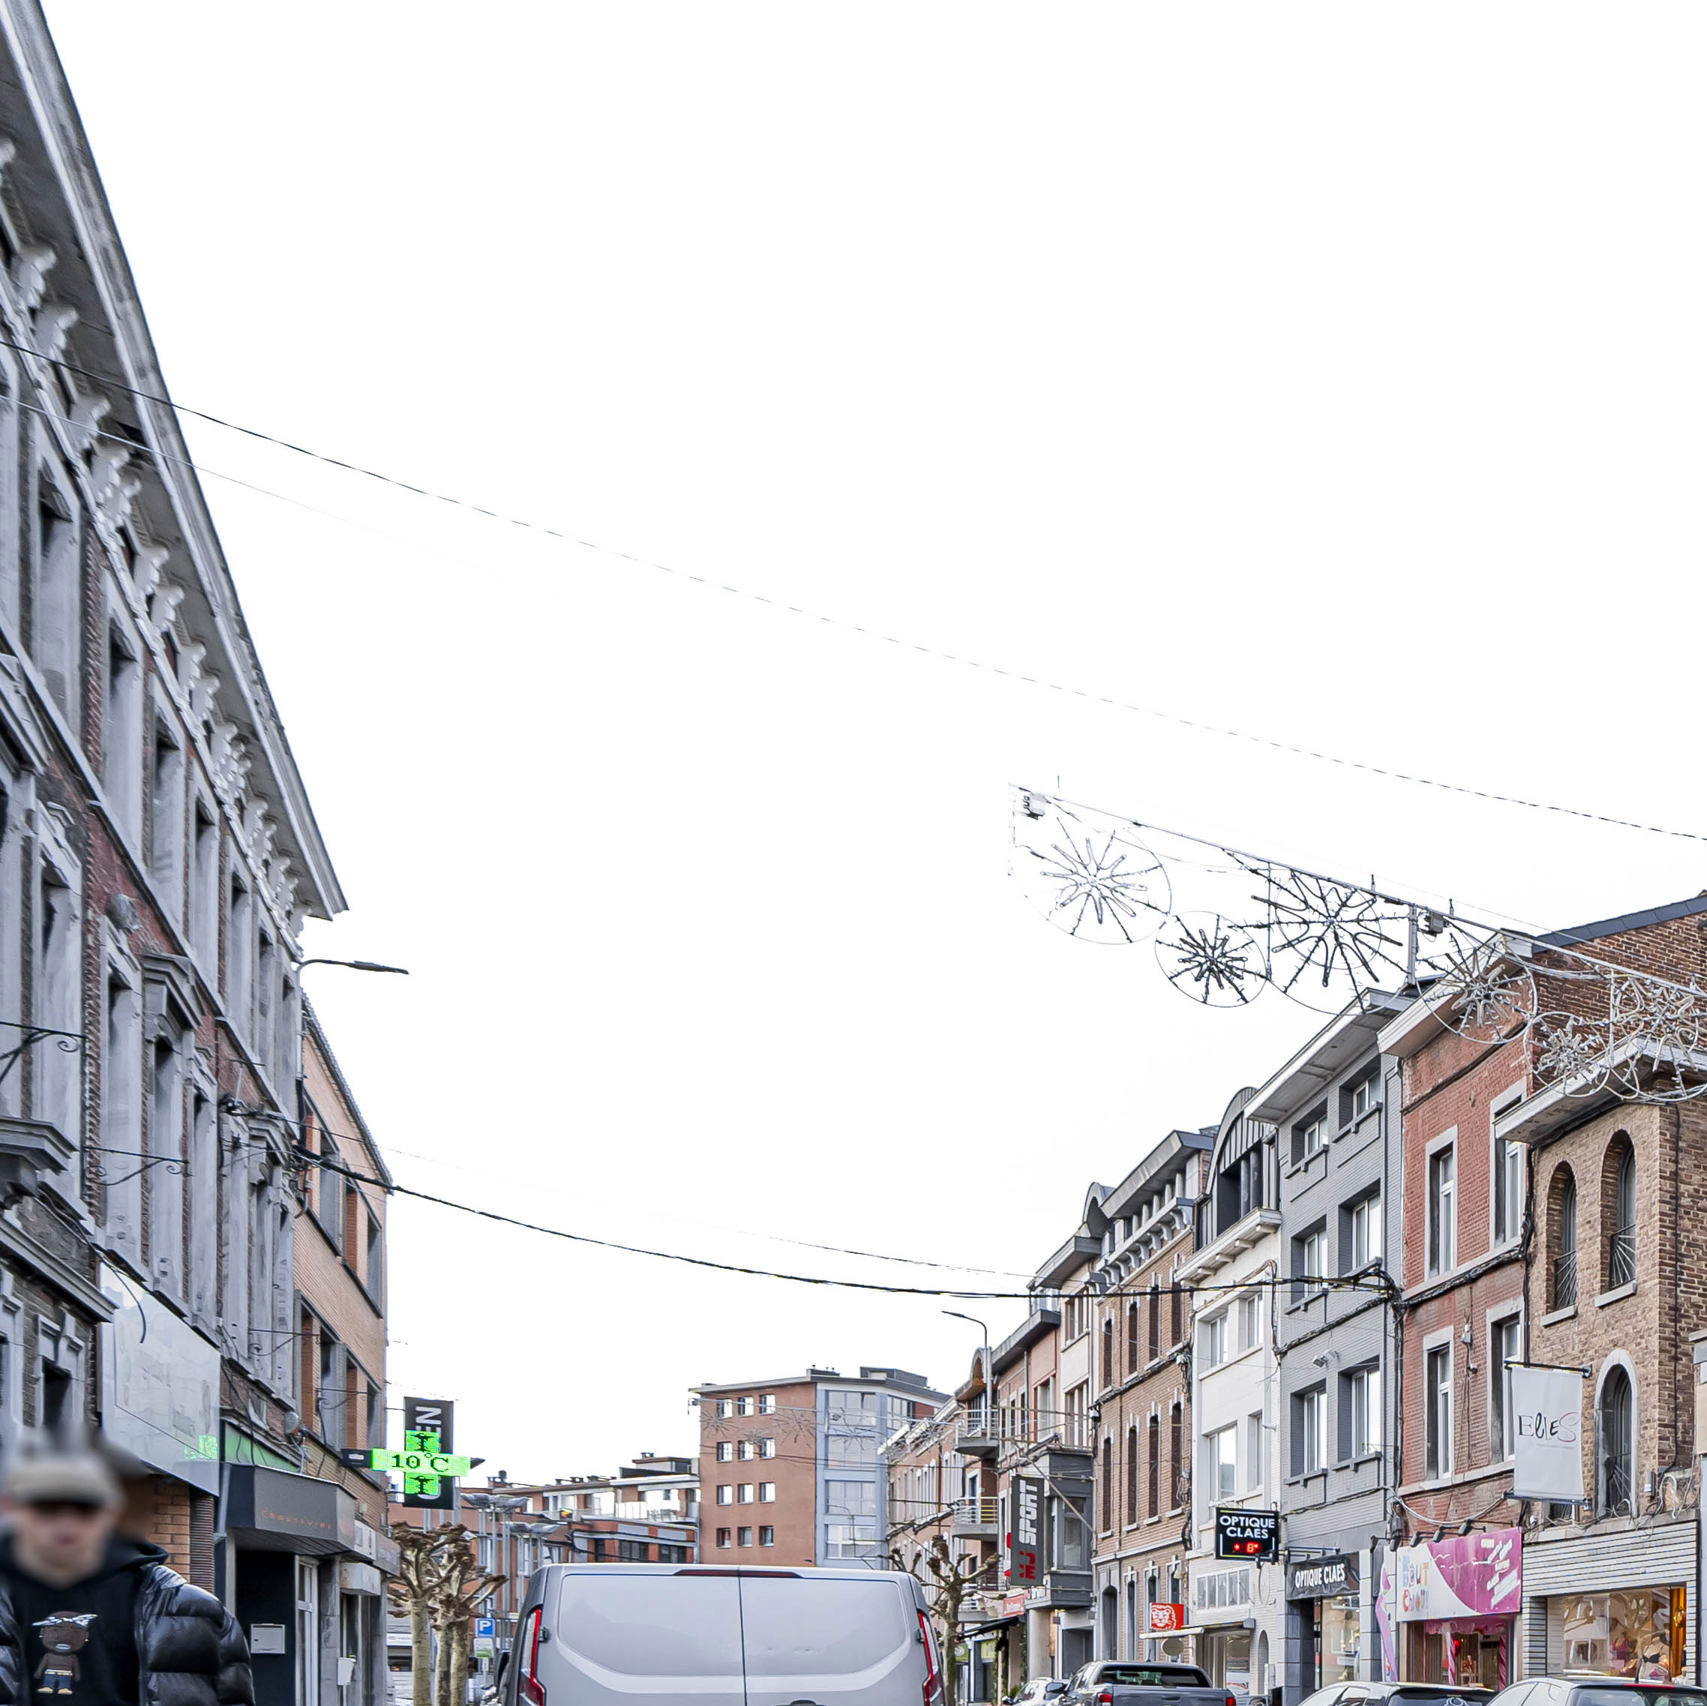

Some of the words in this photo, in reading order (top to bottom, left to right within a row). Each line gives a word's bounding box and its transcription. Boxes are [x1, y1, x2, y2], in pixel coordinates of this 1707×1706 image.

[1018, 1479, 1038, 1546] SPORT
[1219, 1515, 1275, 1529] OPTIQUE
[1226, 1527, 1269, 1539] CLAES
[1295, 1568, 1322, 1589] OPTIQUE
[1323, 1563, 1345, 1583] CLAES
[479, 1620, 491, 1632] P
